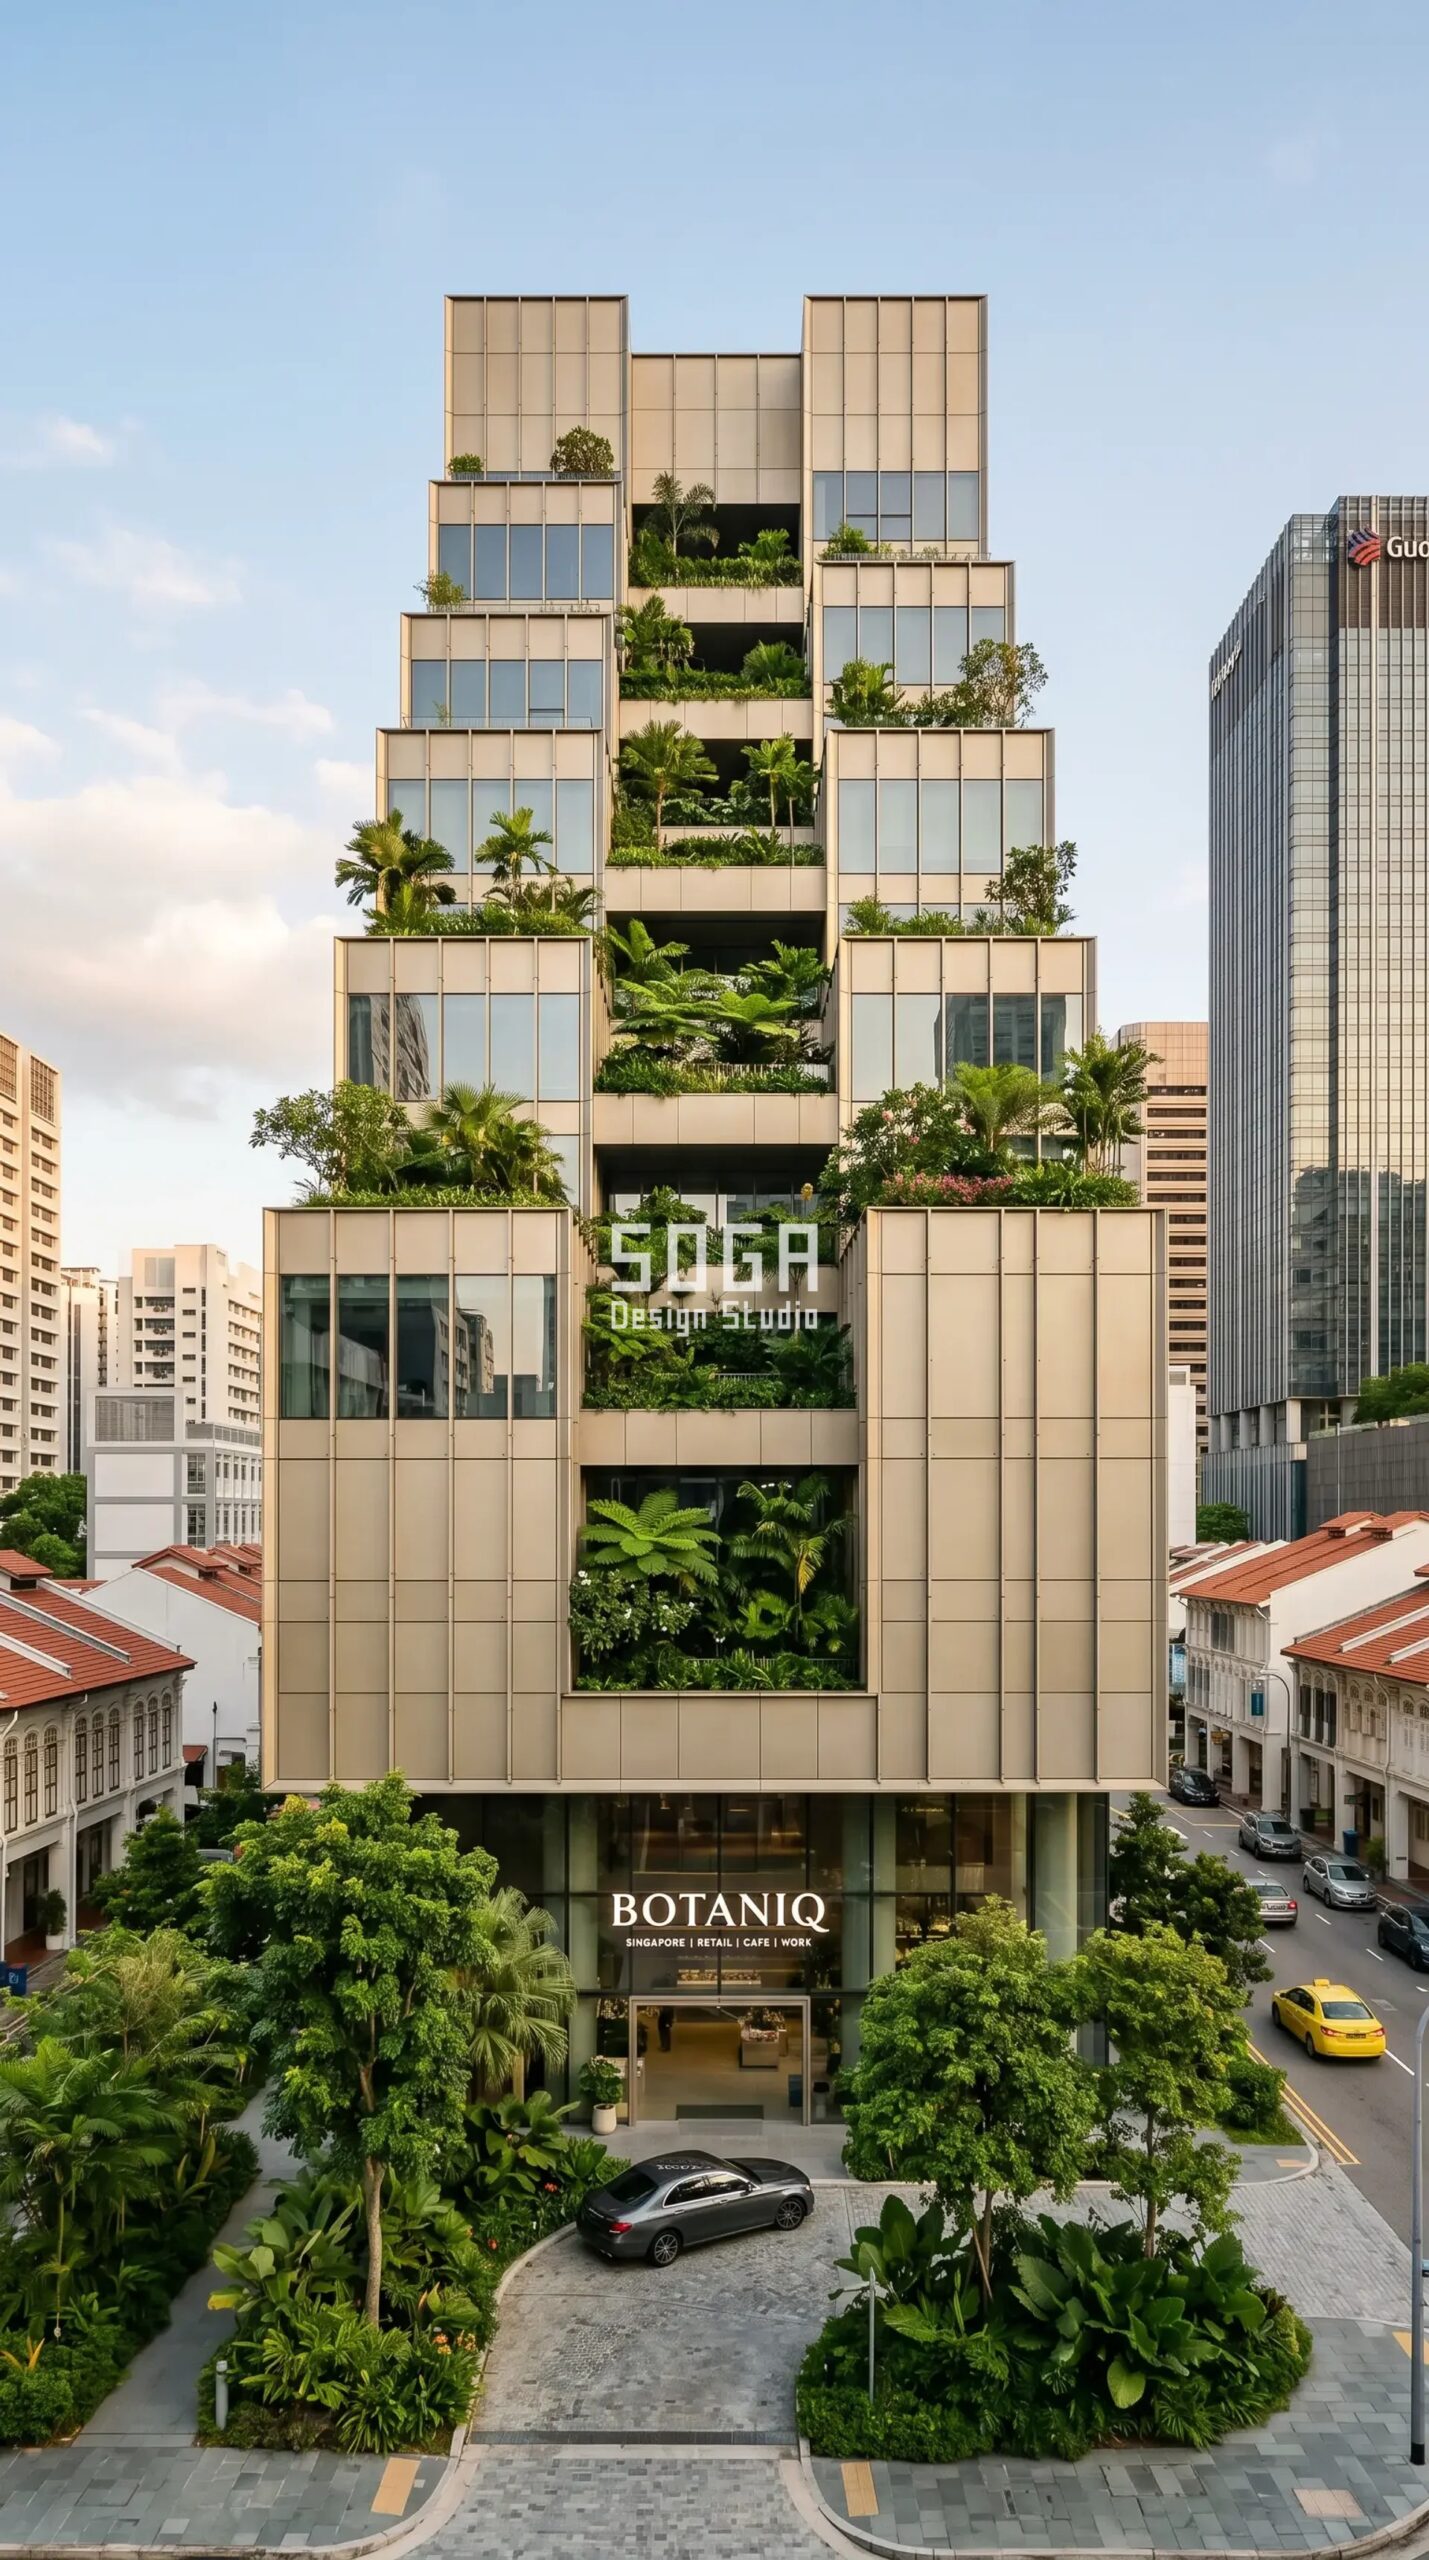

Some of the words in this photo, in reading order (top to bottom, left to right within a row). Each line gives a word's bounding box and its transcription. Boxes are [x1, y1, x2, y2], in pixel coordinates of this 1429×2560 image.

[612, 1892, 830, 1933] BOTANIQ
[625, 1937, 686, 1948] SINGAPORE
[697, 1937, 733, 1948] RETAIL
[743, 1937, 770, 1948] CAFE
[781, 1937, 812, 1948] WORK
